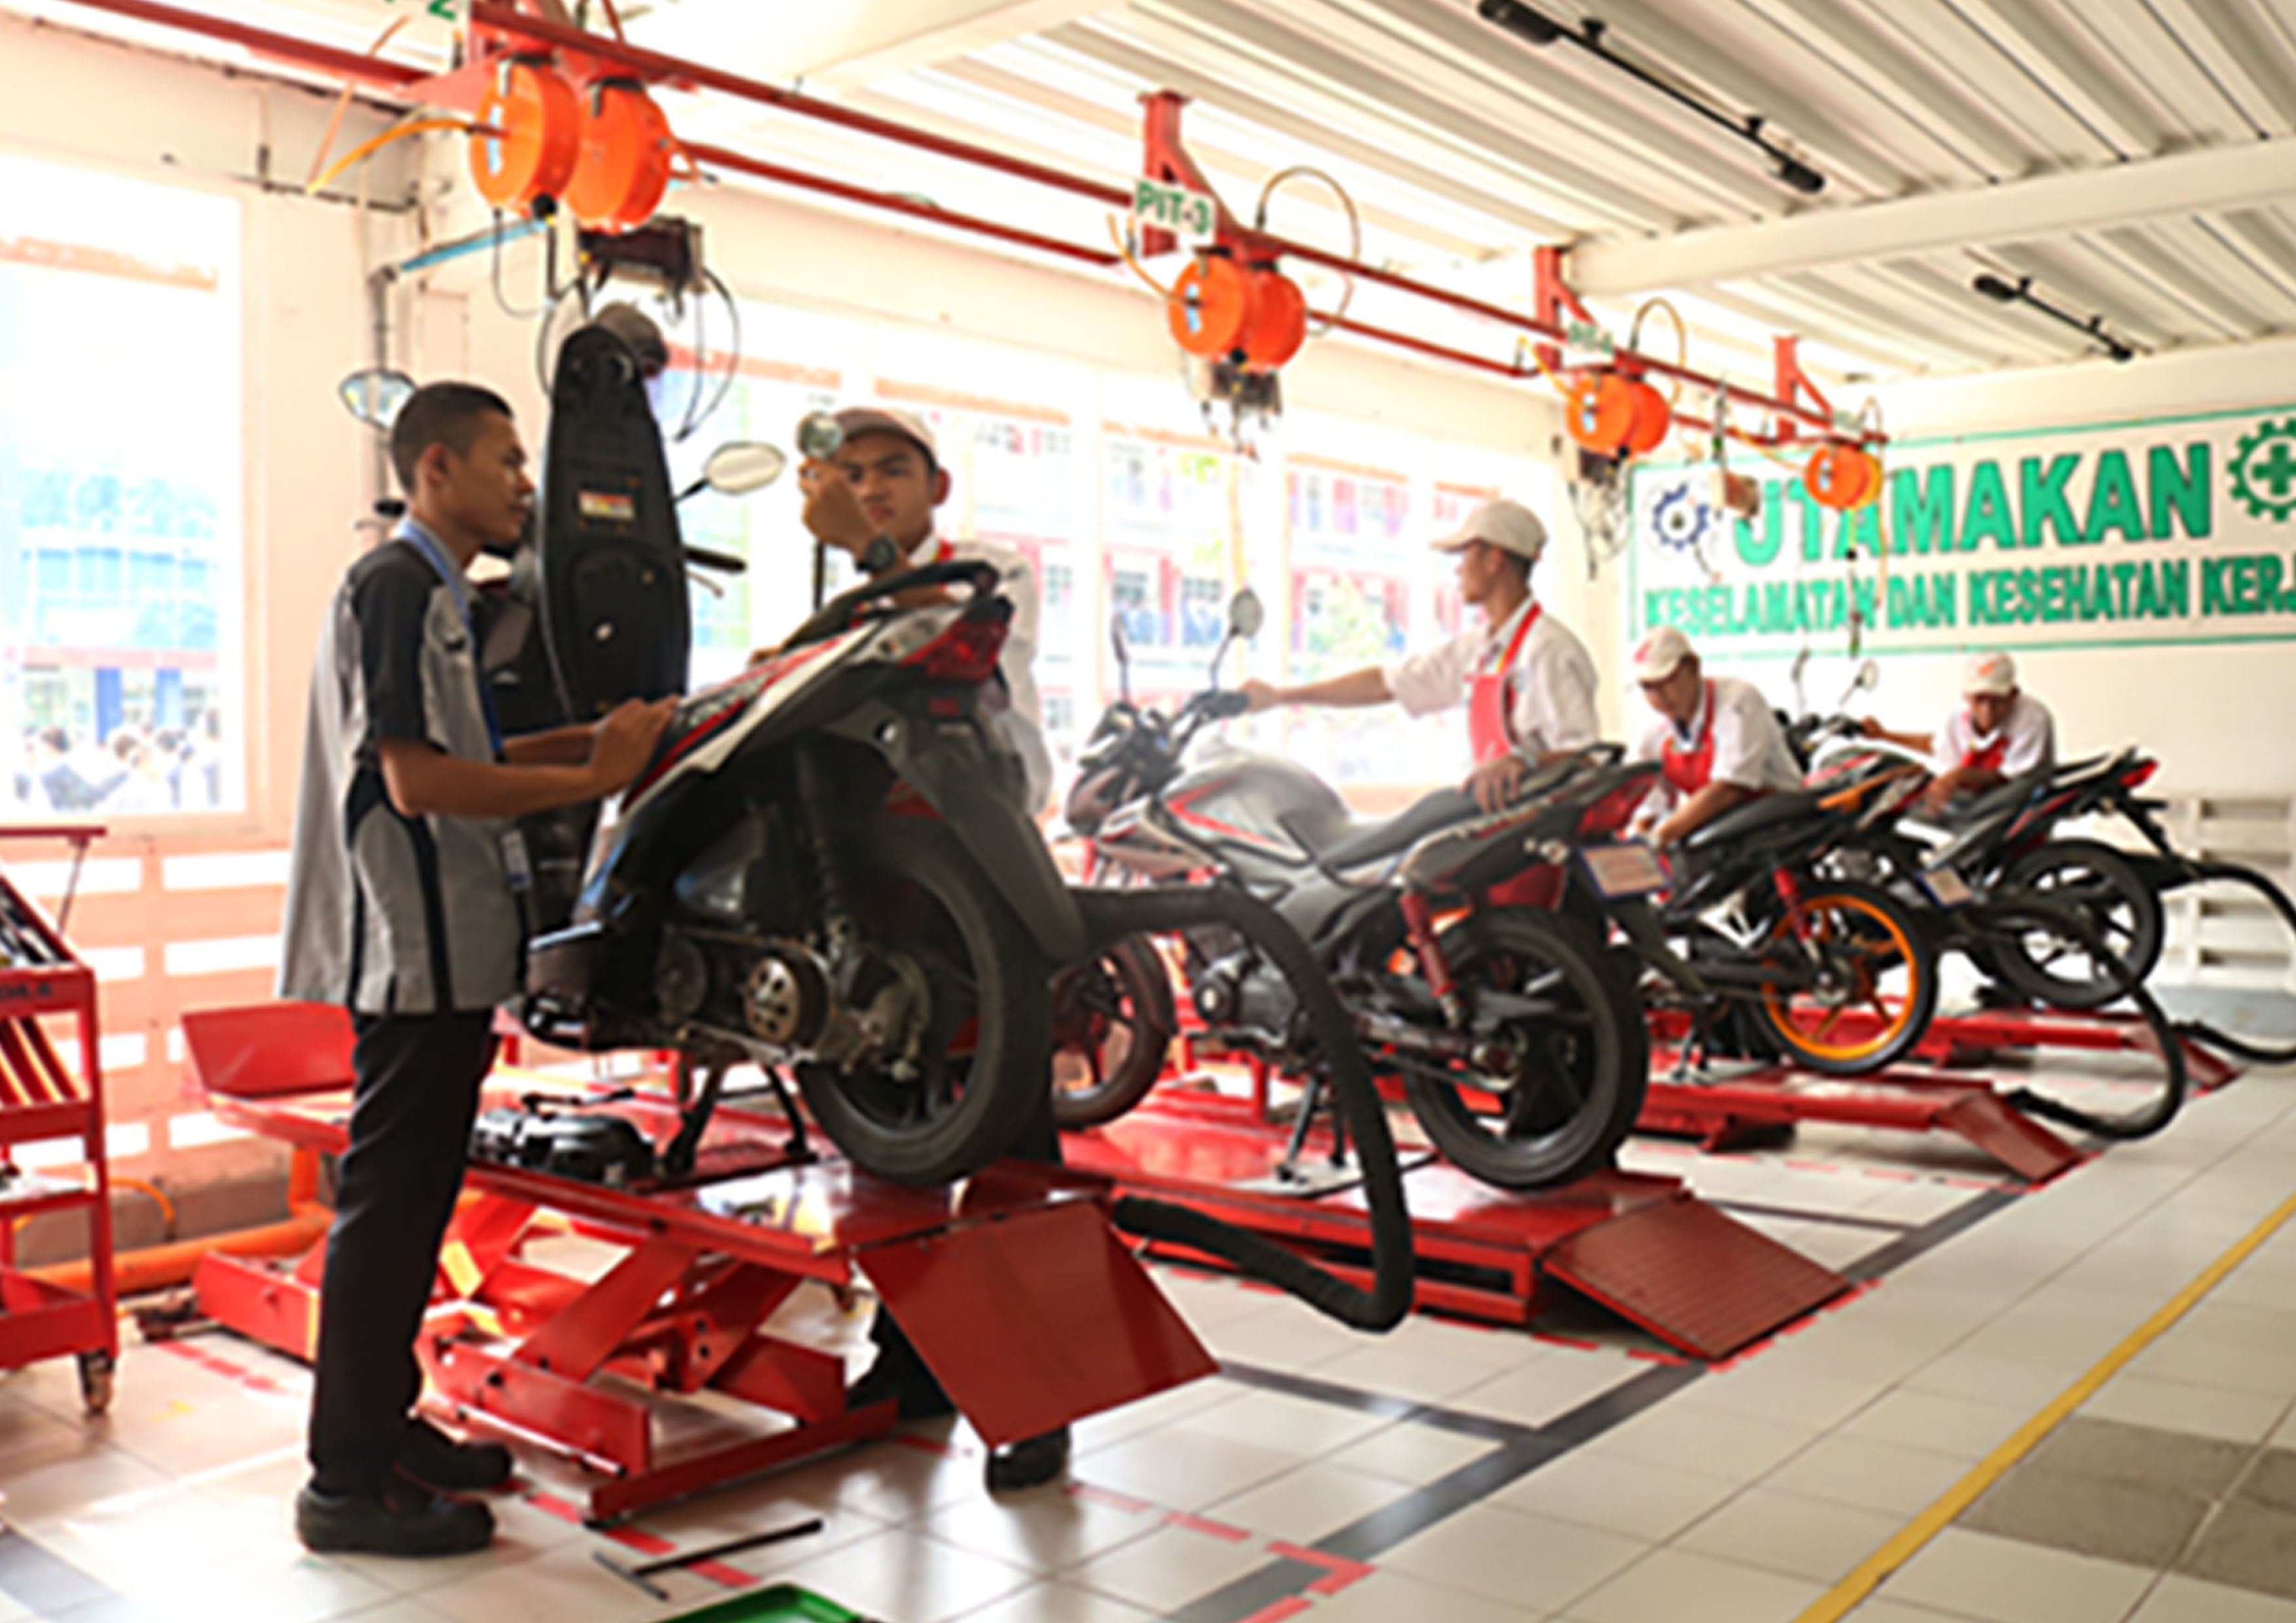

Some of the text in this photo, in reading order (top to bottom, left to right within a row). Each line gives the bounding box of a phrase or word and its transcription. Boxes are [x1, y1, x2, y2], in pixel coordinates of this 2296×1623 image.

[1136, 181, 1211, 234] PIT-3
[1733, 442, 2212, 567] UTAMAKAN
[1645, 576, 1876, 636] KESELAMATAN
[1886, 571, 1956, 629] DAN
[1967, 559, 2189, 625] KESEHATAN
